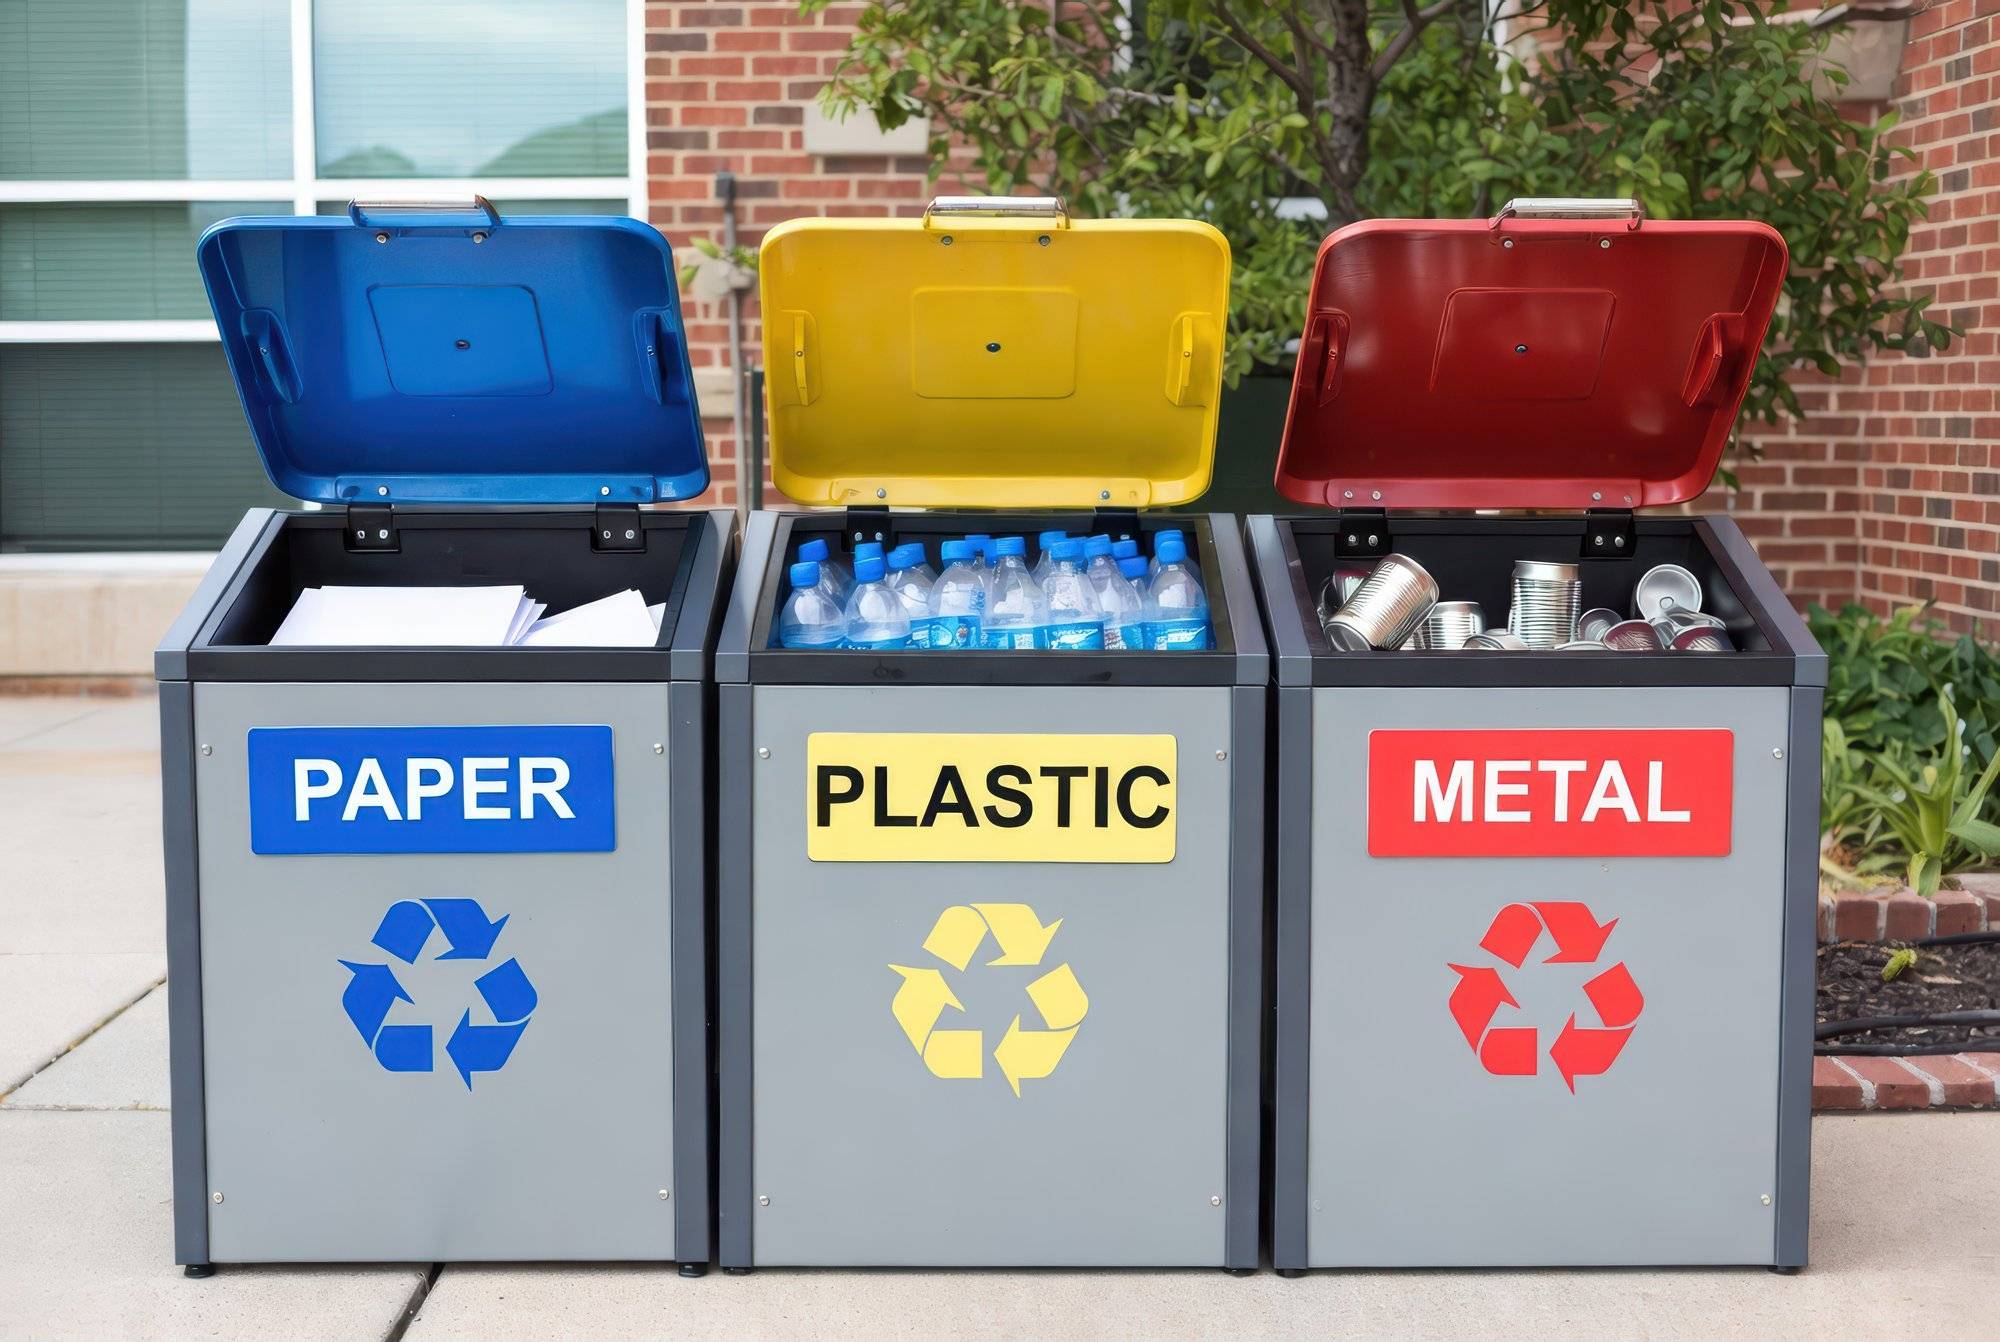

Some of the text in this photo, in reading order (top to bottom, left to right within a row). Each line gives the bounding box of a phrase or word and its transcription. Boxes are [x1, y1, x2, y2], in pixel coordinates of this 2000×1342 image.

[294, 756, 576, 821] PAPER
[816, 764, 1171, 829] PLASTIC
[1413, 759, 1692, 823] METAL
